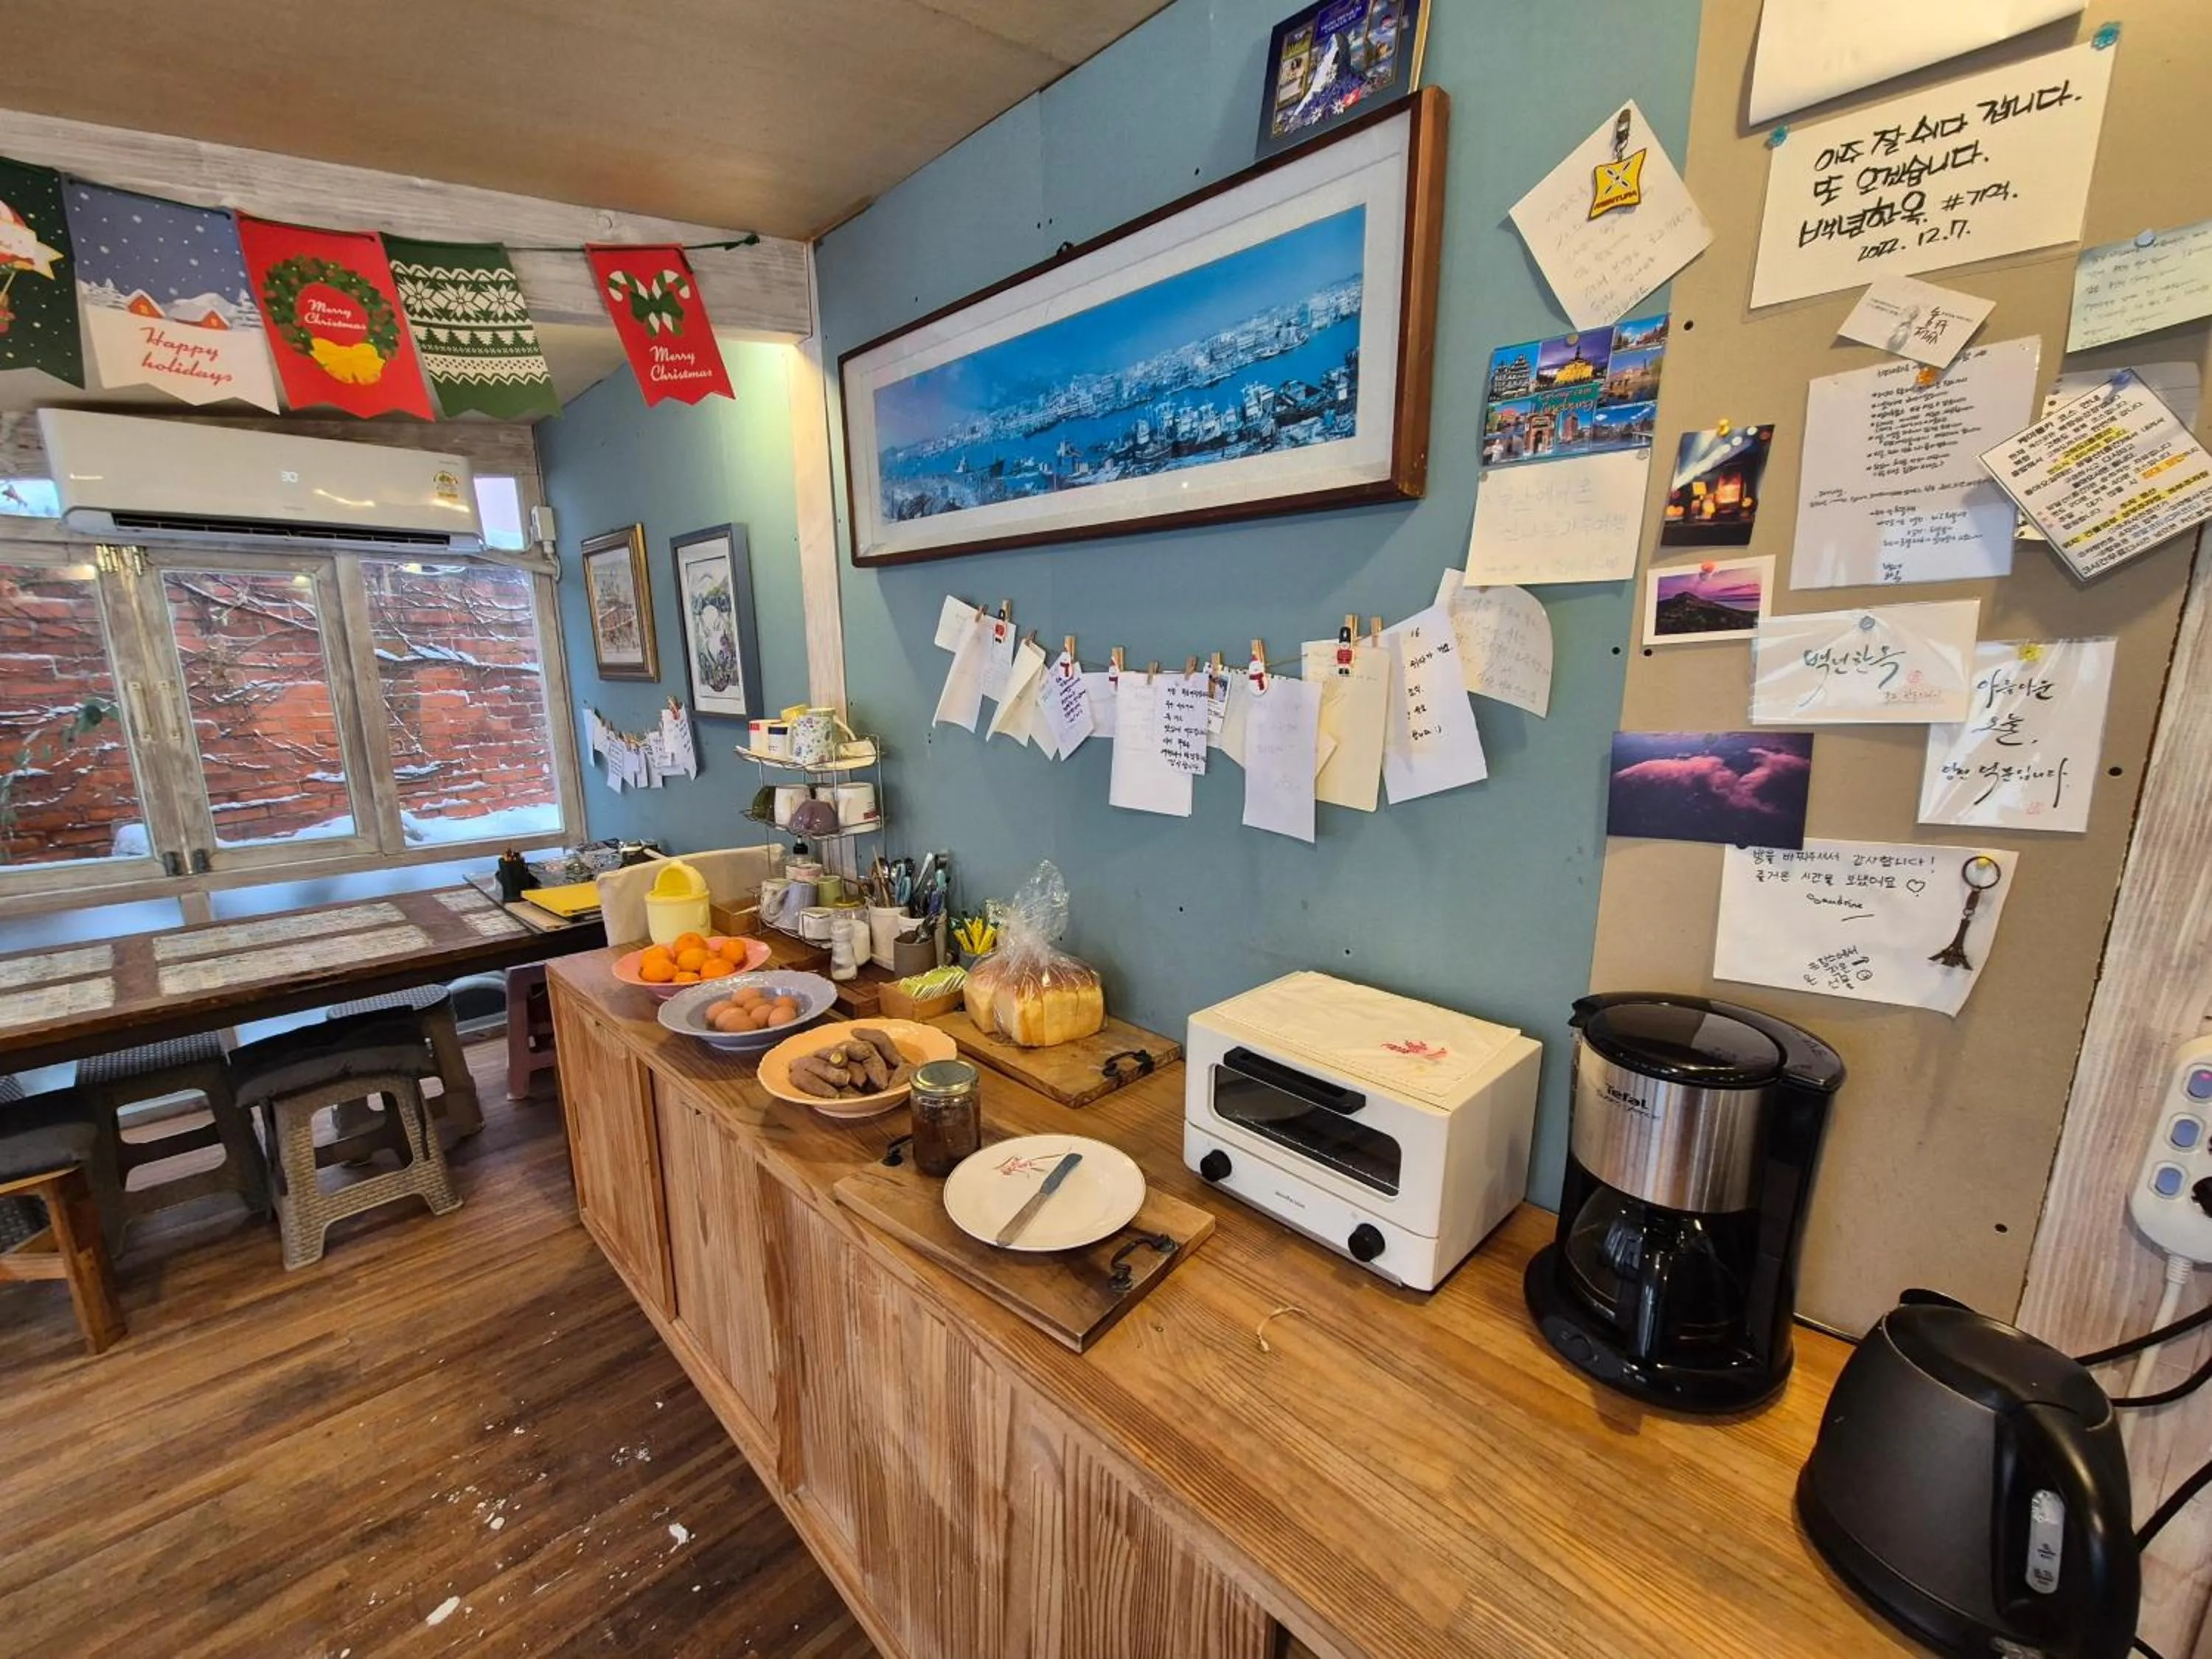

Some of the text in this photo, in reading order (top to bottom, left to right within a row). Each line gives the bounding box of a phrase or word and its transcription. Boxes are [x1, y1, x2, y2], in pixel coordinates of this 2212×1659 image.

[1814, 140, 1865, 171] 아주
[1871, 124, 1905, 156] 잘
[1905, 114, 1968, 146] 쉬다
[1814, 175, 1844, 206] 또
[305, 313, 366, 330] Christmas
[307, 299, 352, 319] Merry
[139, 327, 218, 361] Happy
[649, 346, 695, 365] Merry
[141, 351, 233, 386] holidays
[650, 364, 713, 381] Christmas
[1977, 669, 2055, 709] 아름다운
[1940, 762, 1971, 782] 당신
